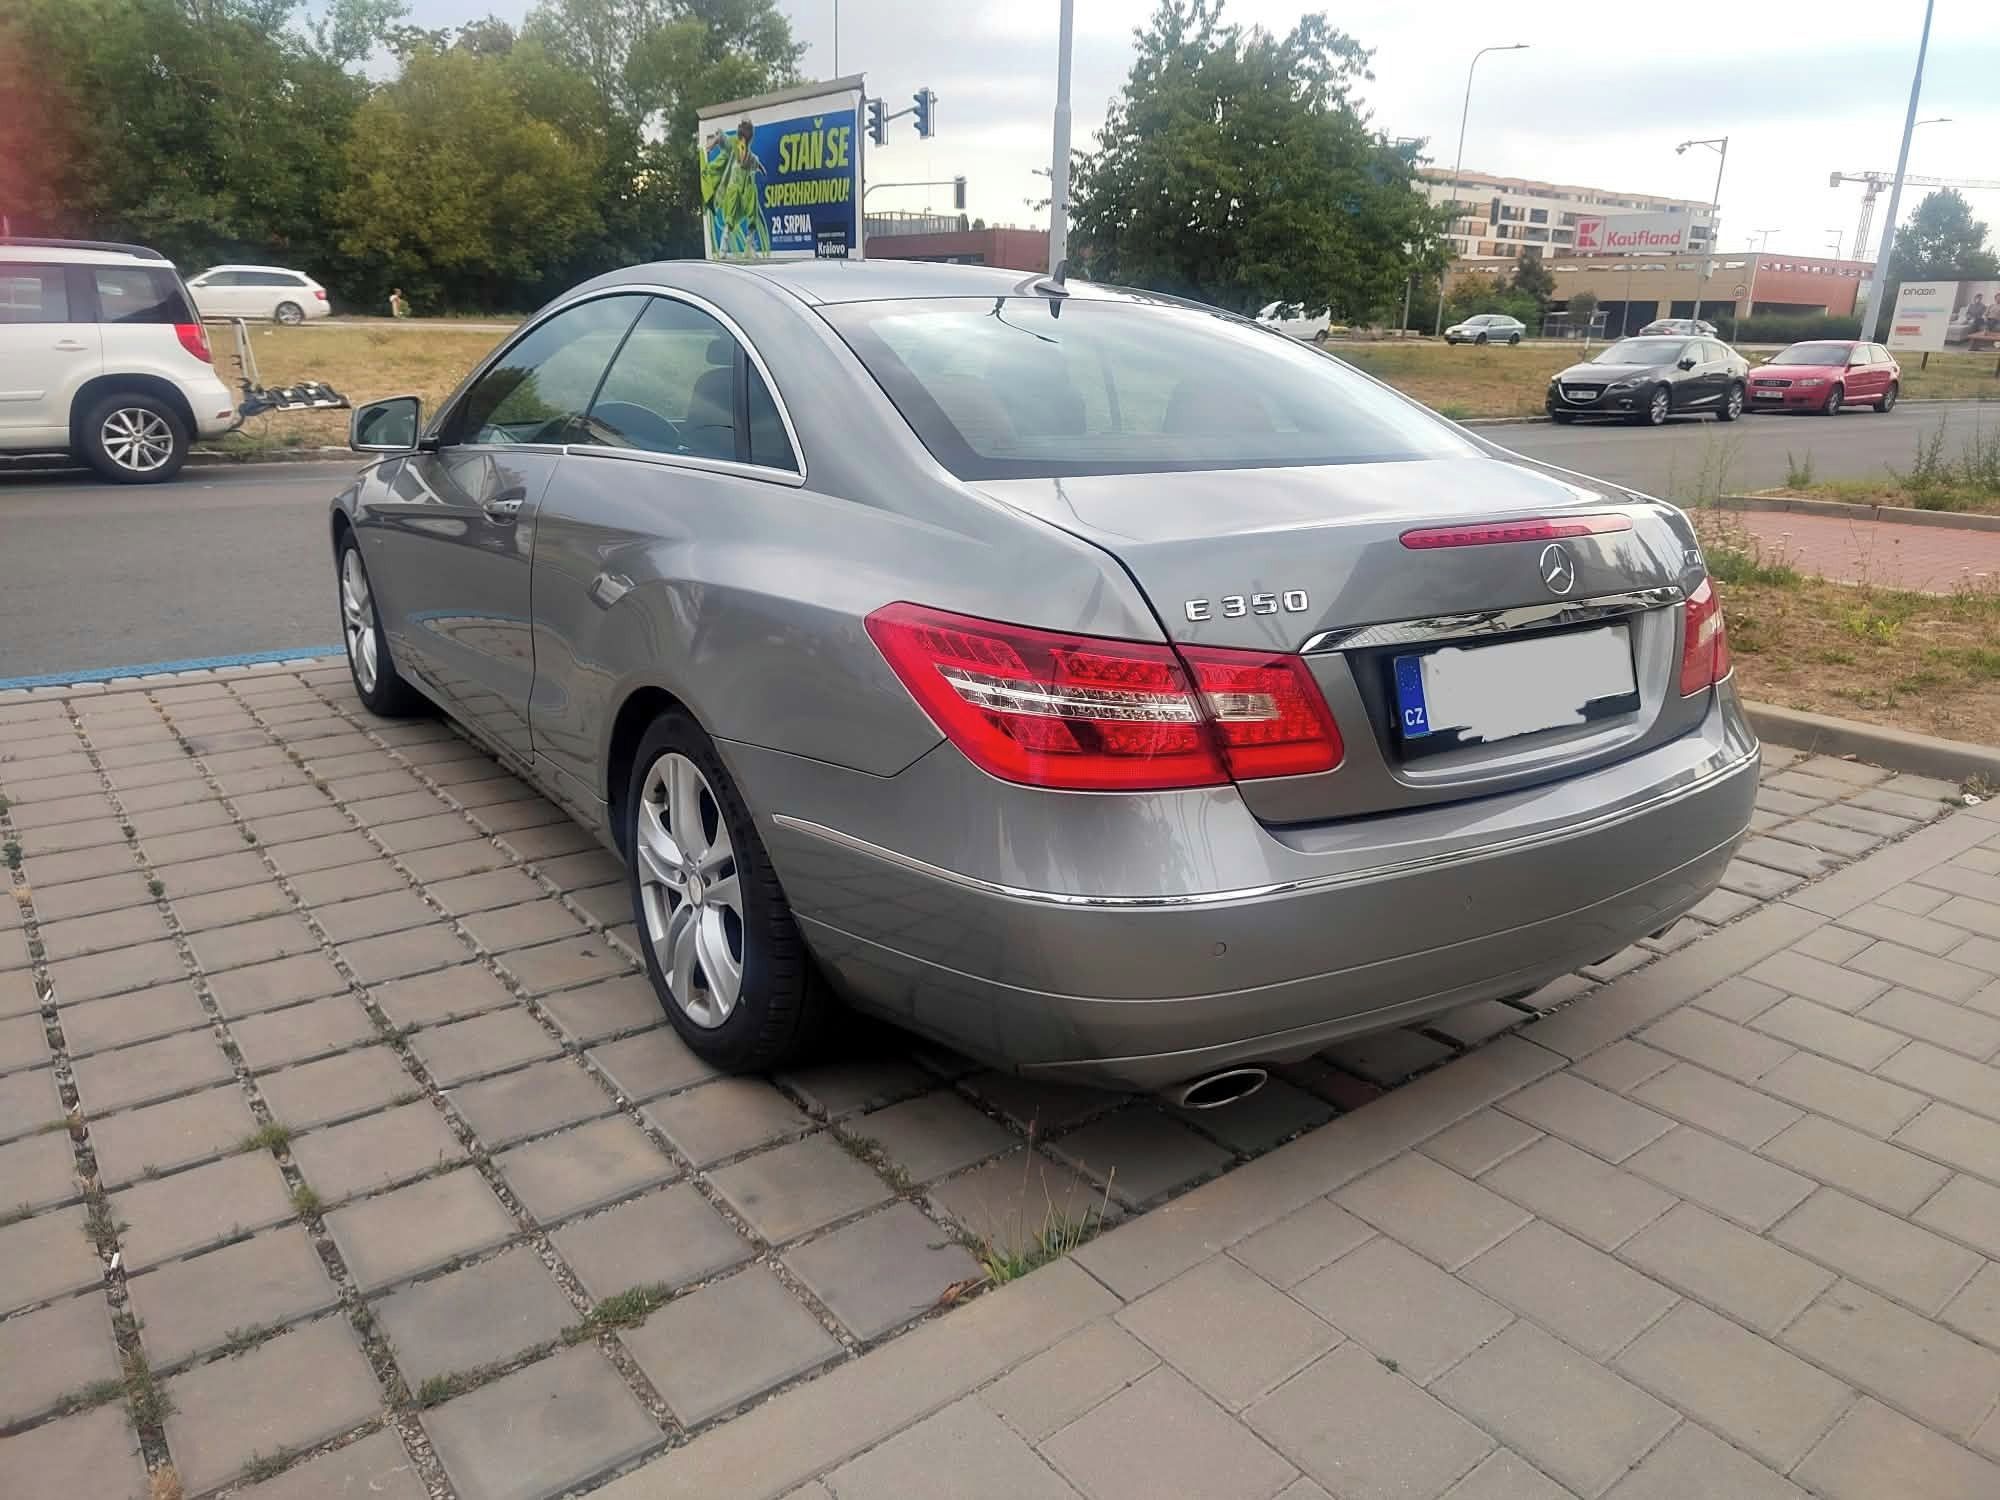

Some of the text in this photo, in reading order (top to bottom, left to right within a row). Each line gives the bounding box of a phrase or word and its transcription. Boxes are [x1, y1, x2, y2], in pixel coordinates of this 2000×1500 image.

[779, 118, 850, 174] STAŇ SE
[764, 178, 850, 208] SUPERHRDINOU!
[771, 214, 812, 234] 29. SRPNA
[818, 240, 845, 255] Královo
[1607, 230, 1681, 246] Kaufland
[1185, 590, 1309, 622] E 350
[1405, 707, 1425, 726] CZ
